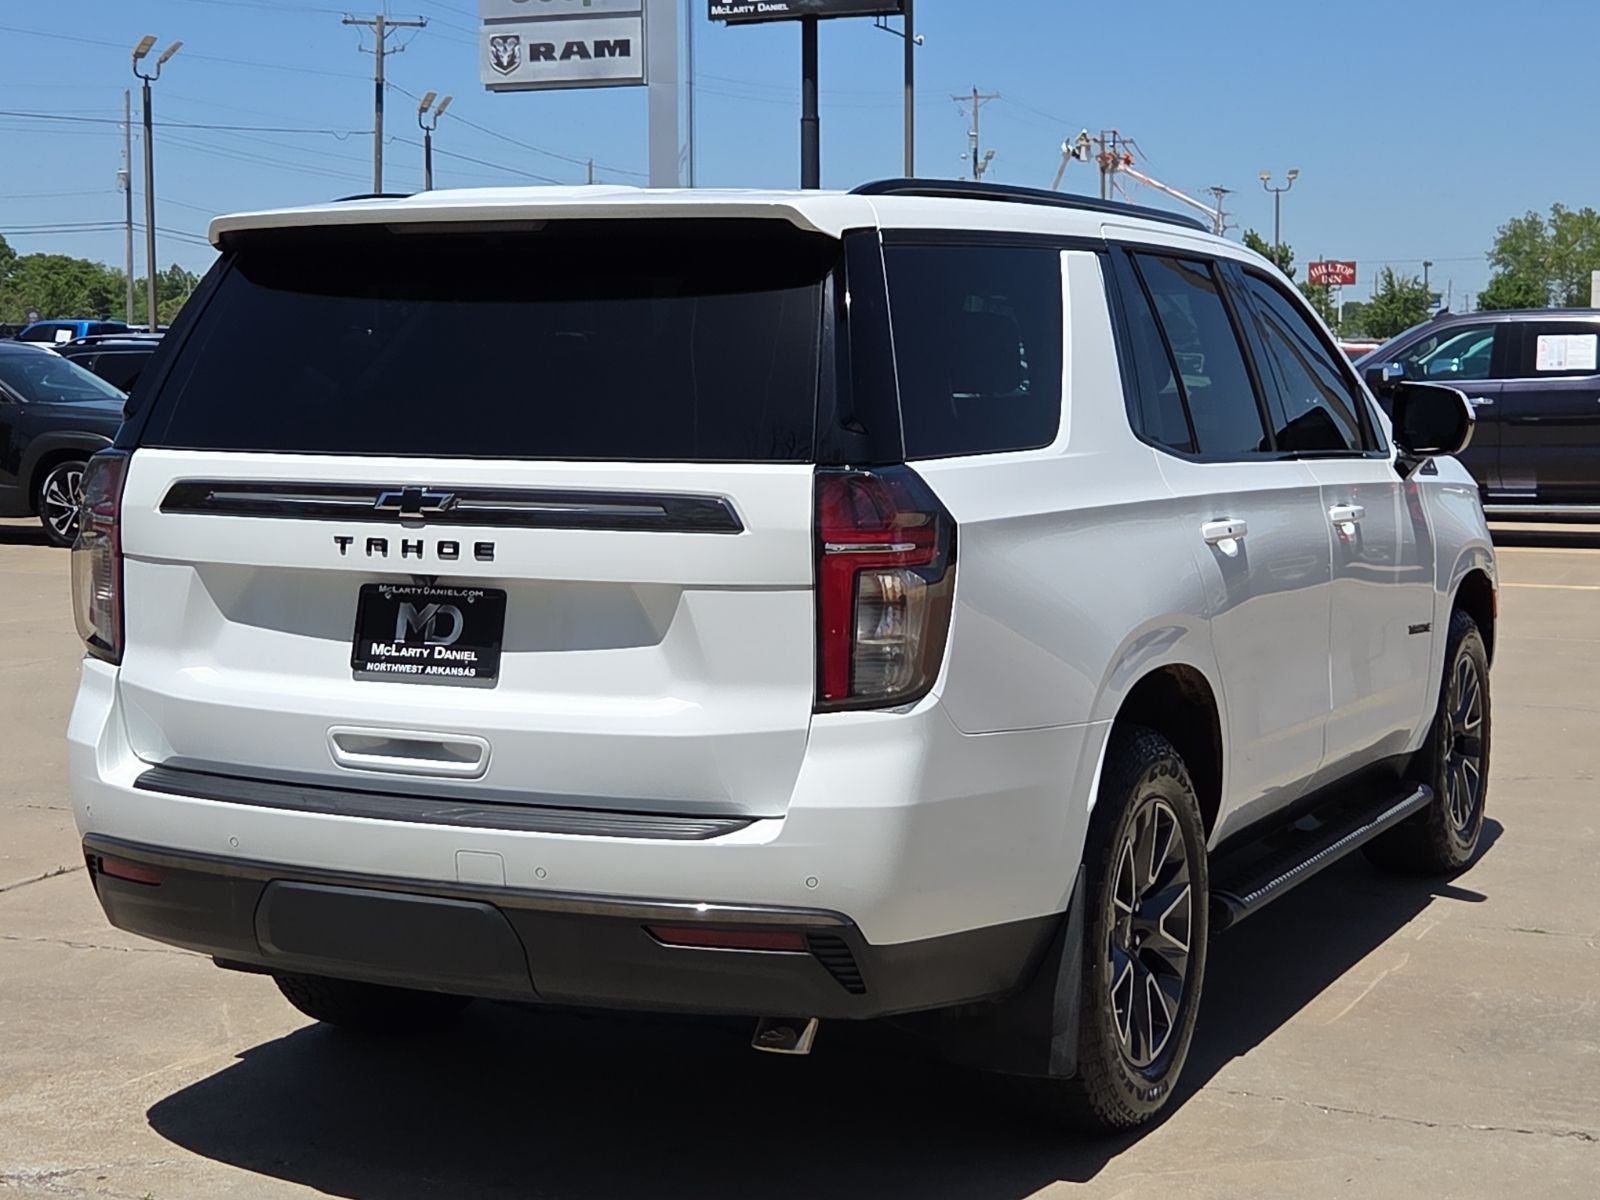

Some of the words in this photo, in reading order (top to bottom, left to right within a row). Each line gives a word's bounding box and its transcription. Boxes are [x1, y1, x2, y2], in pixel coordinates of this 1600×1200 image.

[529, 38, 631, 62] RAM
[333, 536, 496, 562] TAHOE
[434, 646, 478, 661] DANIEL
[366, 661, 424, 673] NORTHWEST
[425, 665, 476, 677] ARKANSAS
